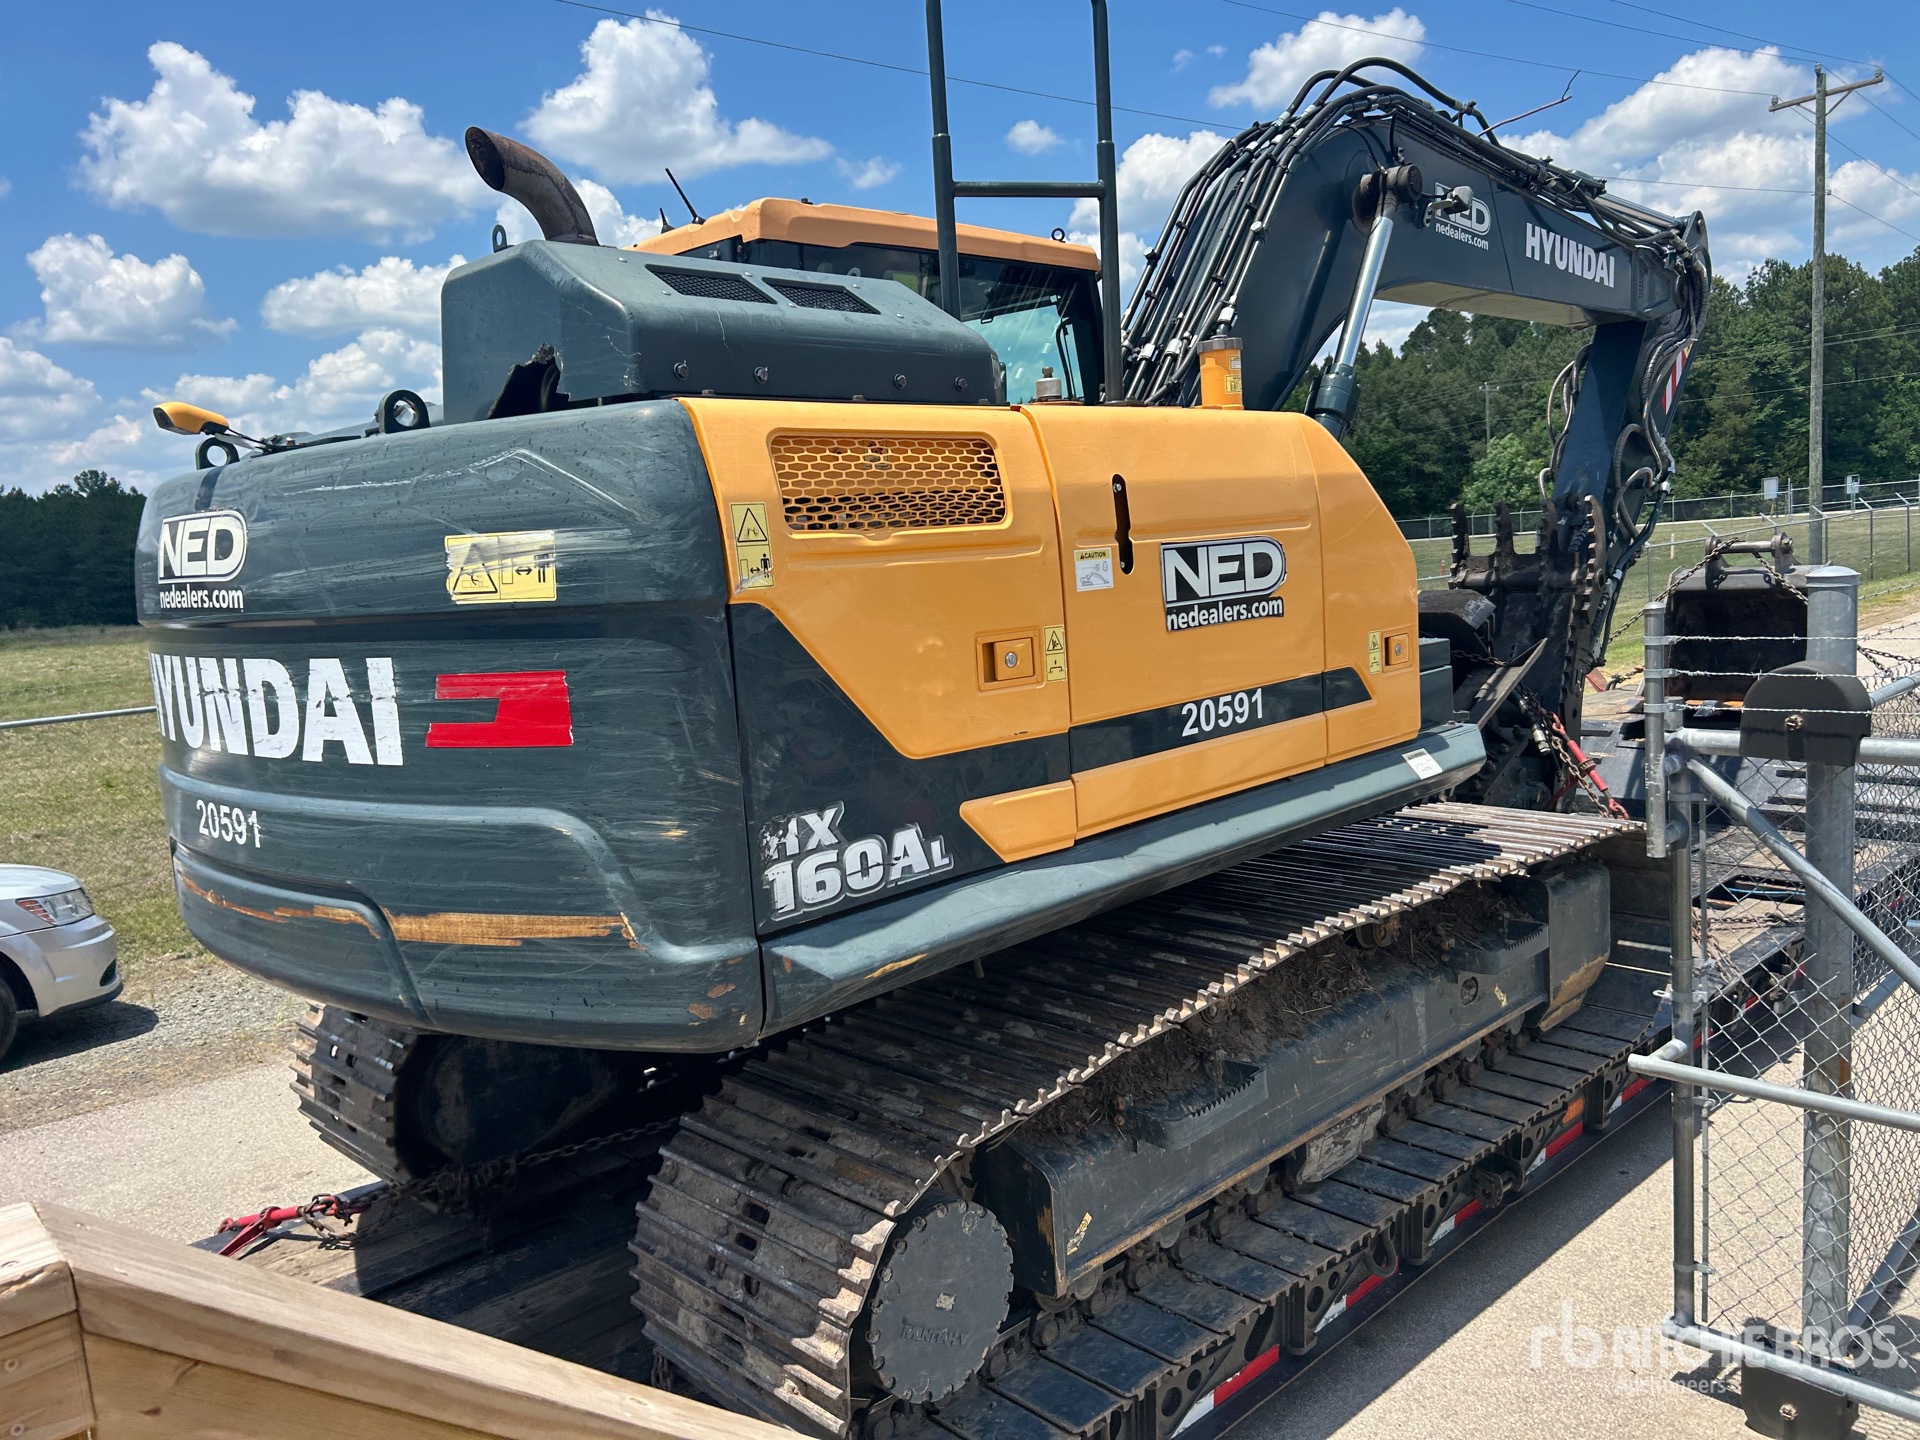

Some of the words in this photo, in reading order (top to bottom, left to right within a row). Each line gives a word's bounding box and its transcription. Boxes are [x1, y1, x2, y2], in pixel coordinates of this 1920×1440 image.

[1435, 222, 1489, 251] nedealers.com
[1525, 222, 1615, 288] HYUNDAI
[159, 516, 244, 579] NED
[1084, 551, 1106, 559] CAUTION
[1163, 541, 1284, 601] NED
[159, 583, 244, 610] nedealers.com
[1167, 598, 1283, 631] nedealers.com
[149, 652, 403, 766] HYUNDAI
[1181, 687, 1263, 737] 20591
[196, 799, 261, 848] 20591
